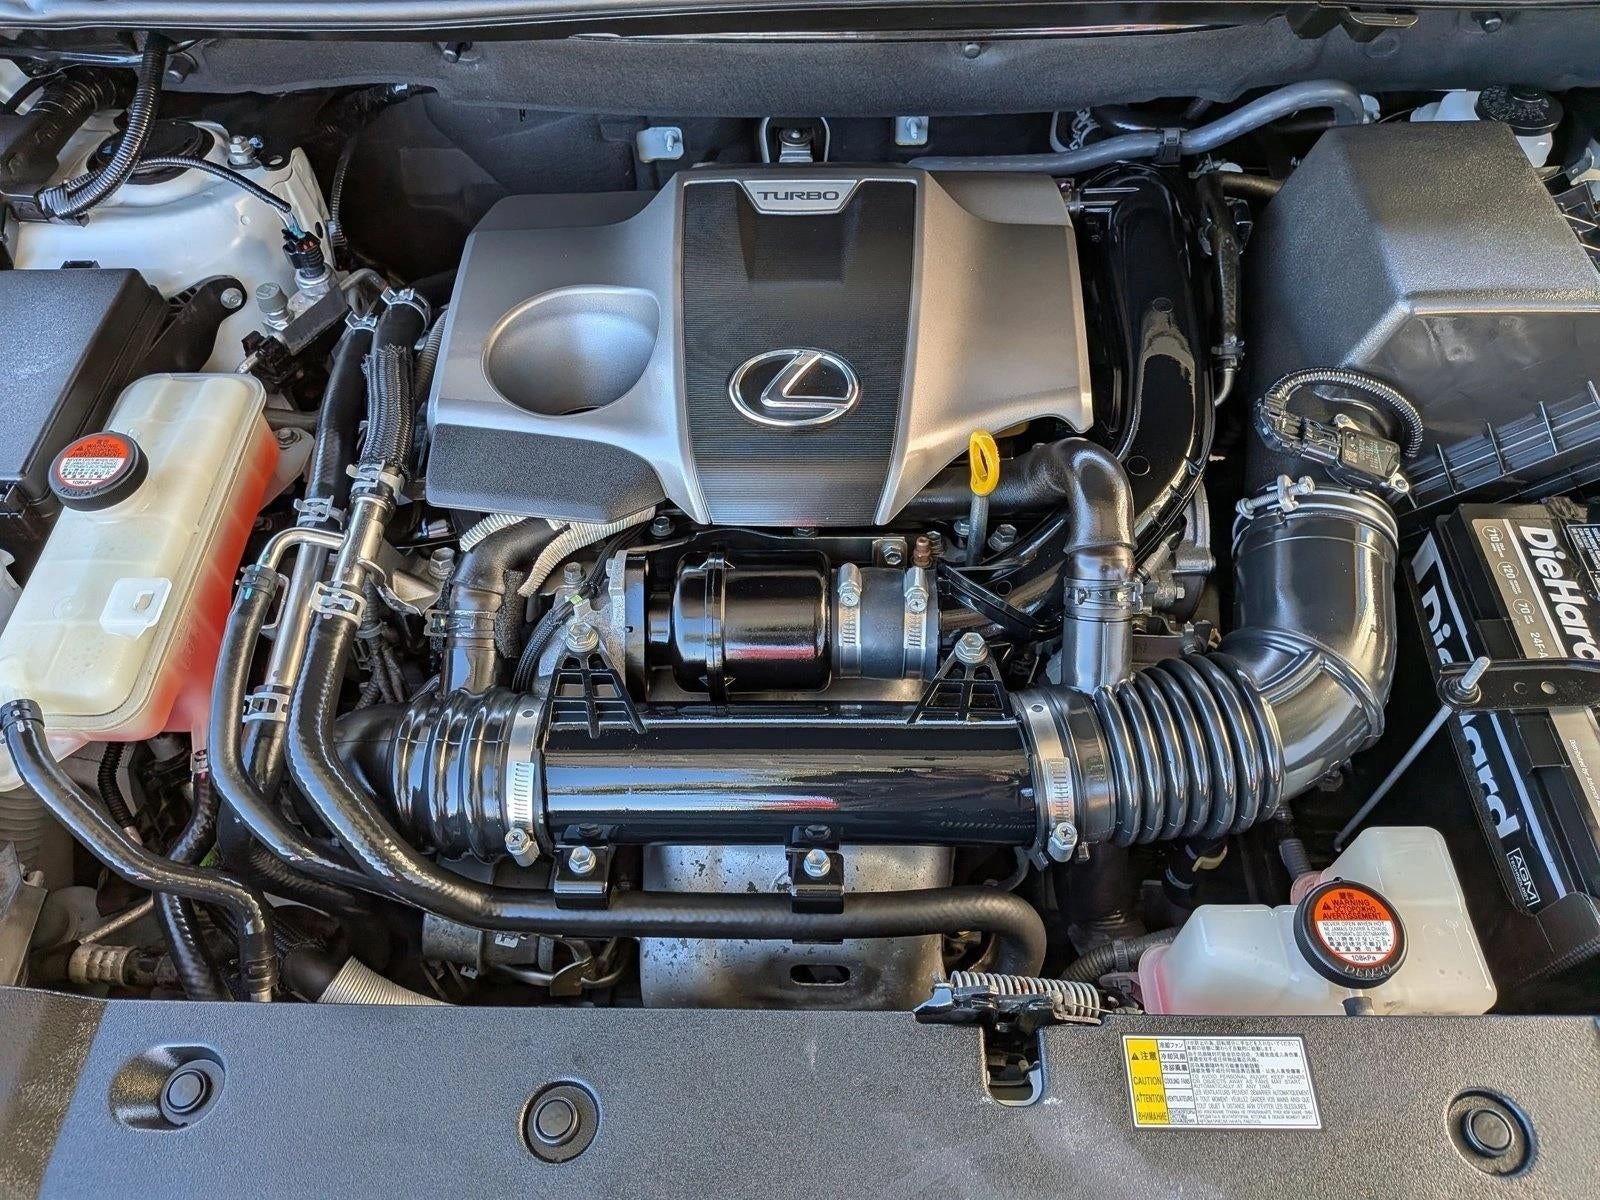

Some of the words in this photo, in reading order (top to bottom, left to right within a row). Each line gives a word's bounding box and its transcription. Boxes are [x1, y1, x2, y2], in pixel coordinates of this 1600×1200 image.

[757, 191, 839, 201] TURBO
[1487, 528, 1500, 542] 710
[1501, 564, 1516, 579] 120
[1518, 602, 1531, 614] 70
[1510, 856, 1529, 902] TECHNOLOGY
[1514, 855, 1536, 901] AGM
[1345, 964, 1391, 978] DENSO
[1141, 1051, 1157, 1061] 注意
[1134, 1077, 1161, 1085] CAUTION
[1136, 1093, 1164, 1103] ATTENTION
